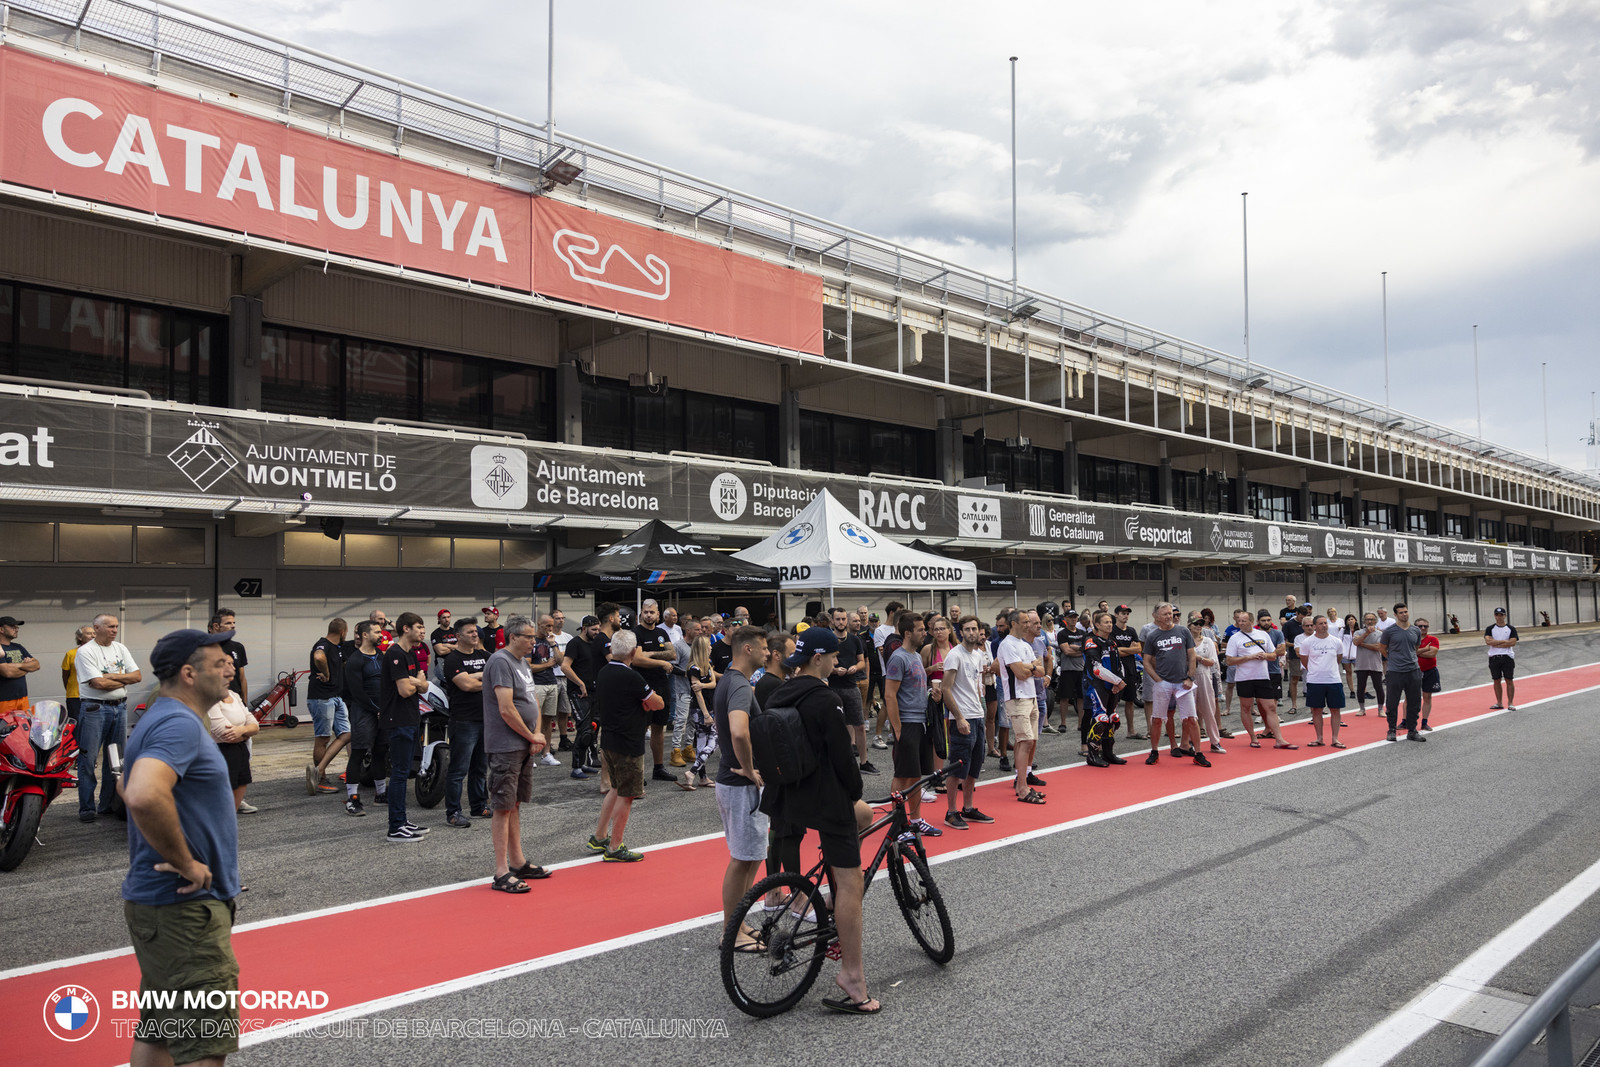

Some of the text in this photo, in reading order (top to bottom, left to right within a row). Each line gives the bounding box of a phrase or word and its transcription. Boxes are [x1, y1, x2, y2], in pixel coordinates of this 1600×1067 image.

[41, 97, 508, 264] CATALUNYA
[246, 443, 397, 470] AJUNTAMENT DE
[246, 464, 397, 492] MONTMELÓ
[536, 459, 646, 488] Ajuntament
[537, 484, 660, 512] de Barcelona
[753, 482, 817, 501] Diputació
[753, 501, 803, 519] Barcelo
[858, 488, 927, 532] RACC
[962, 512, 998, 522] CATALUNYA
[1049, 507, 1097, 525] Generalitat
[1050, 524, 1104, 543] de Catalunya
[1139, 526, 1193, 547] esportcat
[1223, 530, 1248, 539] AJUNTAMENT
[1282, 531, 1309, 543] Ajuntament
[659, 543, 706, 555] BMC
[1224, 538, 1254, 549] MONTMELÓ
[1283, 543, 1313, 554] de Barcelona
[1364, 538, 1386, 560] RACC
[772, 565, 812, 581] RAD
[850, 563, 963, 581] BMW MOTORRAD
[240, 581, 260, 595] 27
[1156, 636, 1183, 649] aprilia
